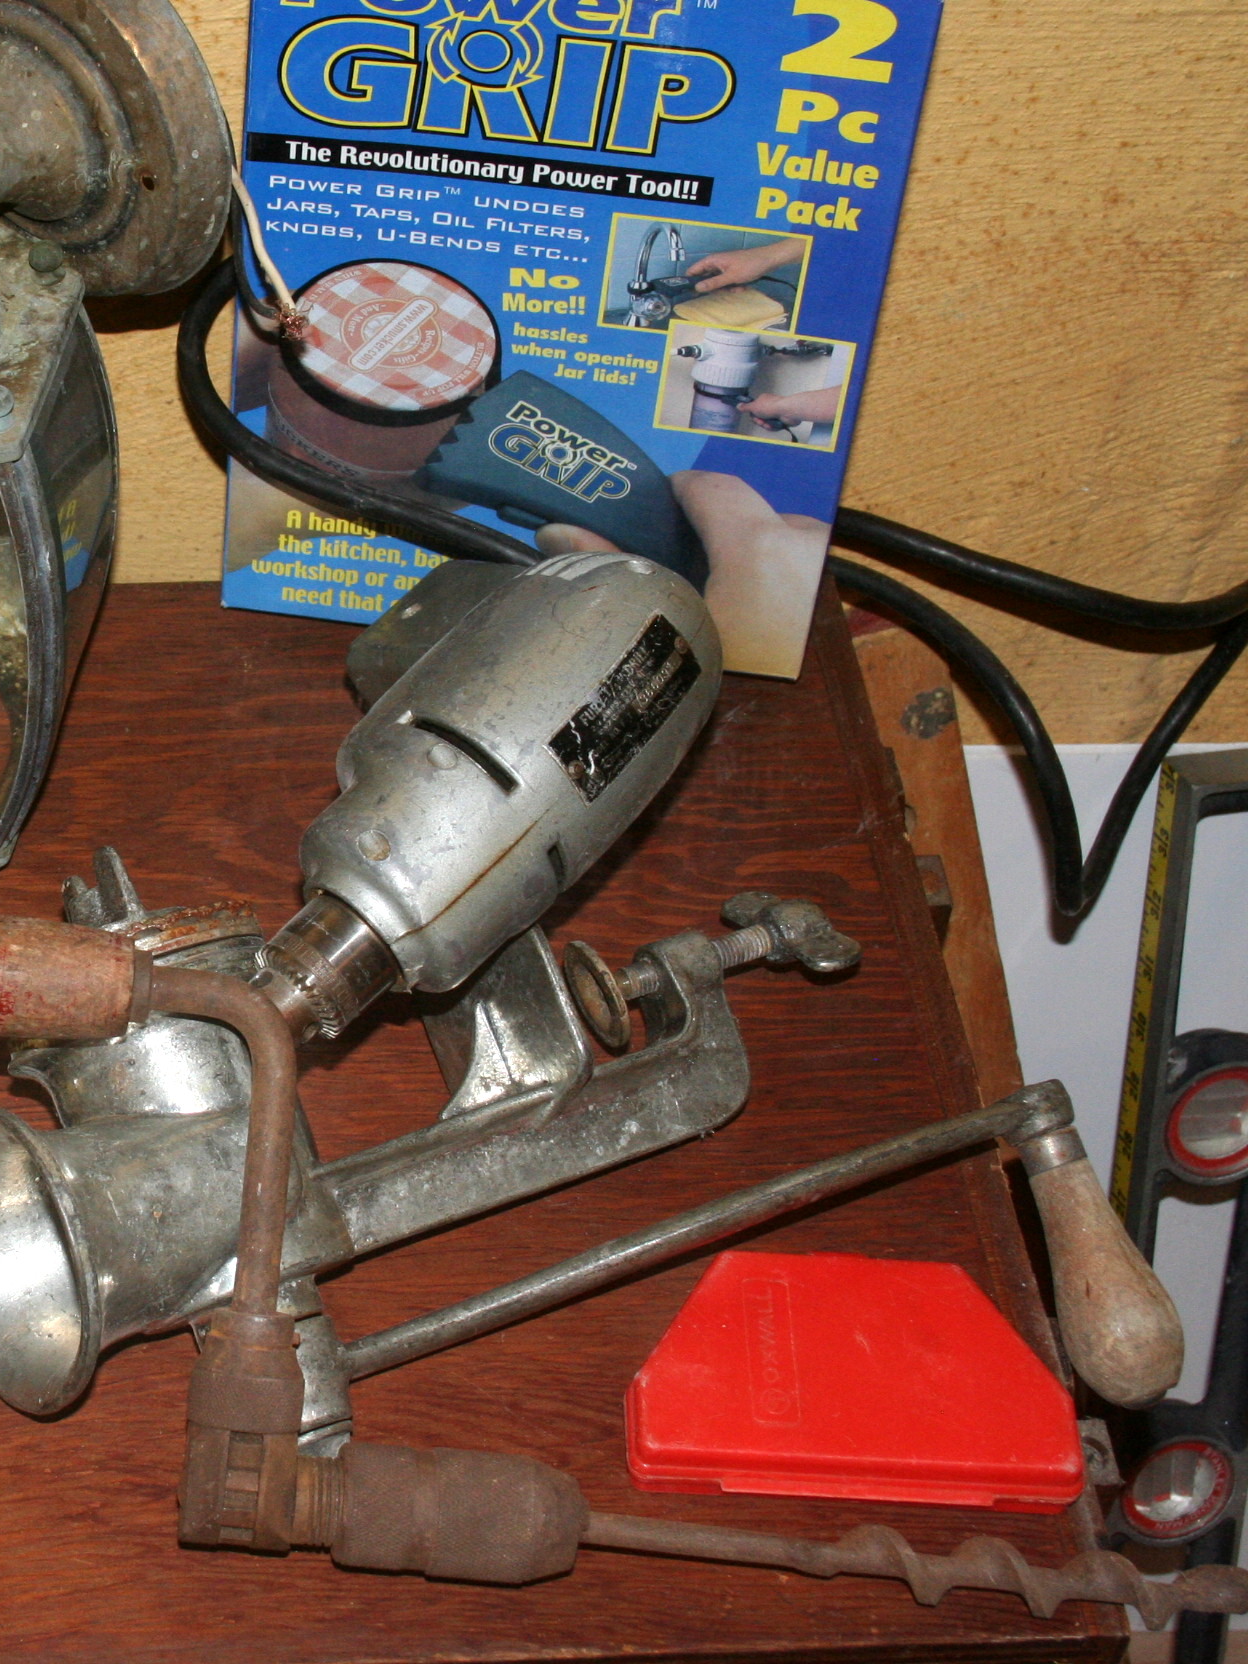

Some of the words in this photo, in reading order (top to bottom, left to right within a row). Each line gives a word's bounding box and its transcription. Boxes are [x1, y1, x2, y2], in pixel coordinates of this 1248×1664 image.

[780, 0, 898, 84] 2
[277, 13, 737, 158] GRIP
[775, 88, 879, 144] Pc
[285, 140, 331, 163] The
[339, 145, 524, 184] Revolutionary
[532, 163, 618, 191] Power
[626, 174, 700, 200] Tool!!
[756, 142, 880, 189] Value
[269, 175, 362, 195] POWER
[474, 195, 585, 218] UNDOES
[755, 187, 861, 231] Pack
[265, 220, 363, 241] KNOBS,
[377, 227, 501, 253] U-BENDS
[513, 244, 588, 263] ETC...
[267, 197, 340, 218] JARS,
[350, 203, 421, 225] TAPS,
[432, 211, 475, 228] OIL
[487, 217, 590, 243] FILTERS,
[502, 292, 586, 315] More!!
[355, 304, 429, 366] www.smucker.com
[513, 322, 589, 343] hassles
[511, 342, 567, 359] when
[574, 351, 659, 374] opening
[554, 364, 586, 380] Jar
[593, 368, 637, 385] lids!
[506, 400, 629, 471] Power
[286, 510, 302, 529] A
[278, 533, 313, 555] the
[319, 538, 407, 567] kitchen,
[251, 559, 359, 587] workshop
[365, 571, 388, 587] or
[281, 586, 333, 606] need
[339, 590, 384, 612] that
